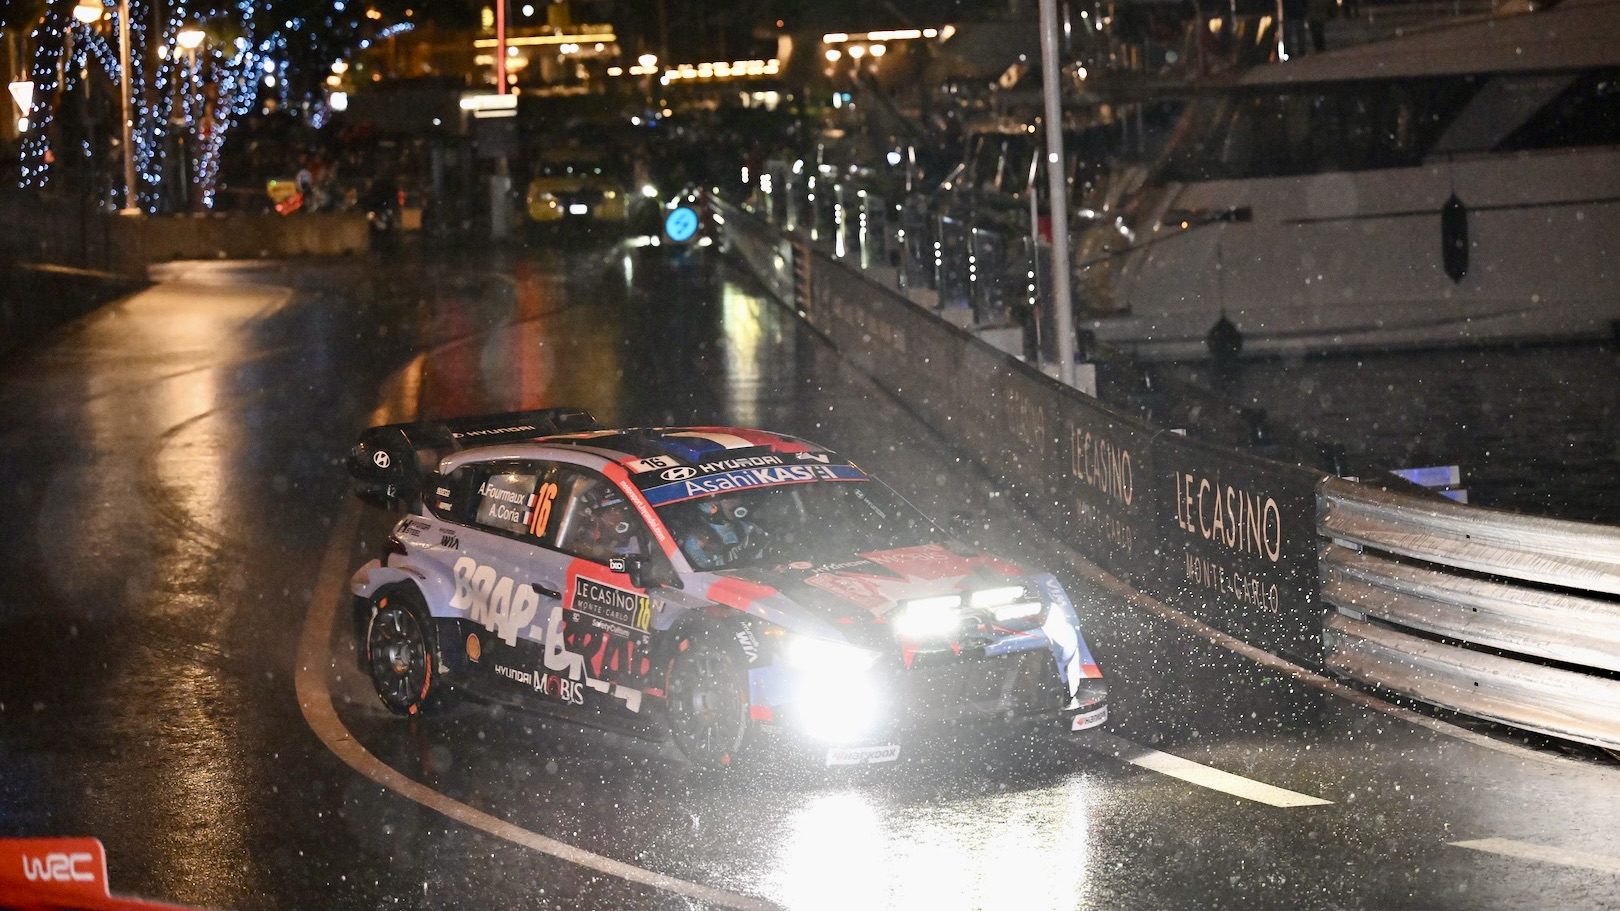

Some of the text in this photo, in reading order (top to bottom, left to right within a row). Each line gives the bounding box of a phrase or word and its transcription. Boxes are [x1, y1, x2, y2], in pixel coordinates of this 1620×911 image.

[640, 456, 668, 469] 16
[699, 456, 783, 473] HYUNDAI
[1085, 431, 1133, 506] CASINO
[477, 482, 525, 505] A.Fourmaux
[489, 503, 520, 523] A.Coria
[530, 482, 558, 538] 16
[1176, 471, 1195, 533] LE
[1198, 478, 1280, 562] CASINO
[577, 581, 635, 611] LE CASINO
[494, 664, 584, 705] HYUNDAI MOBIS
[22, 852, 95, 882] WRC
